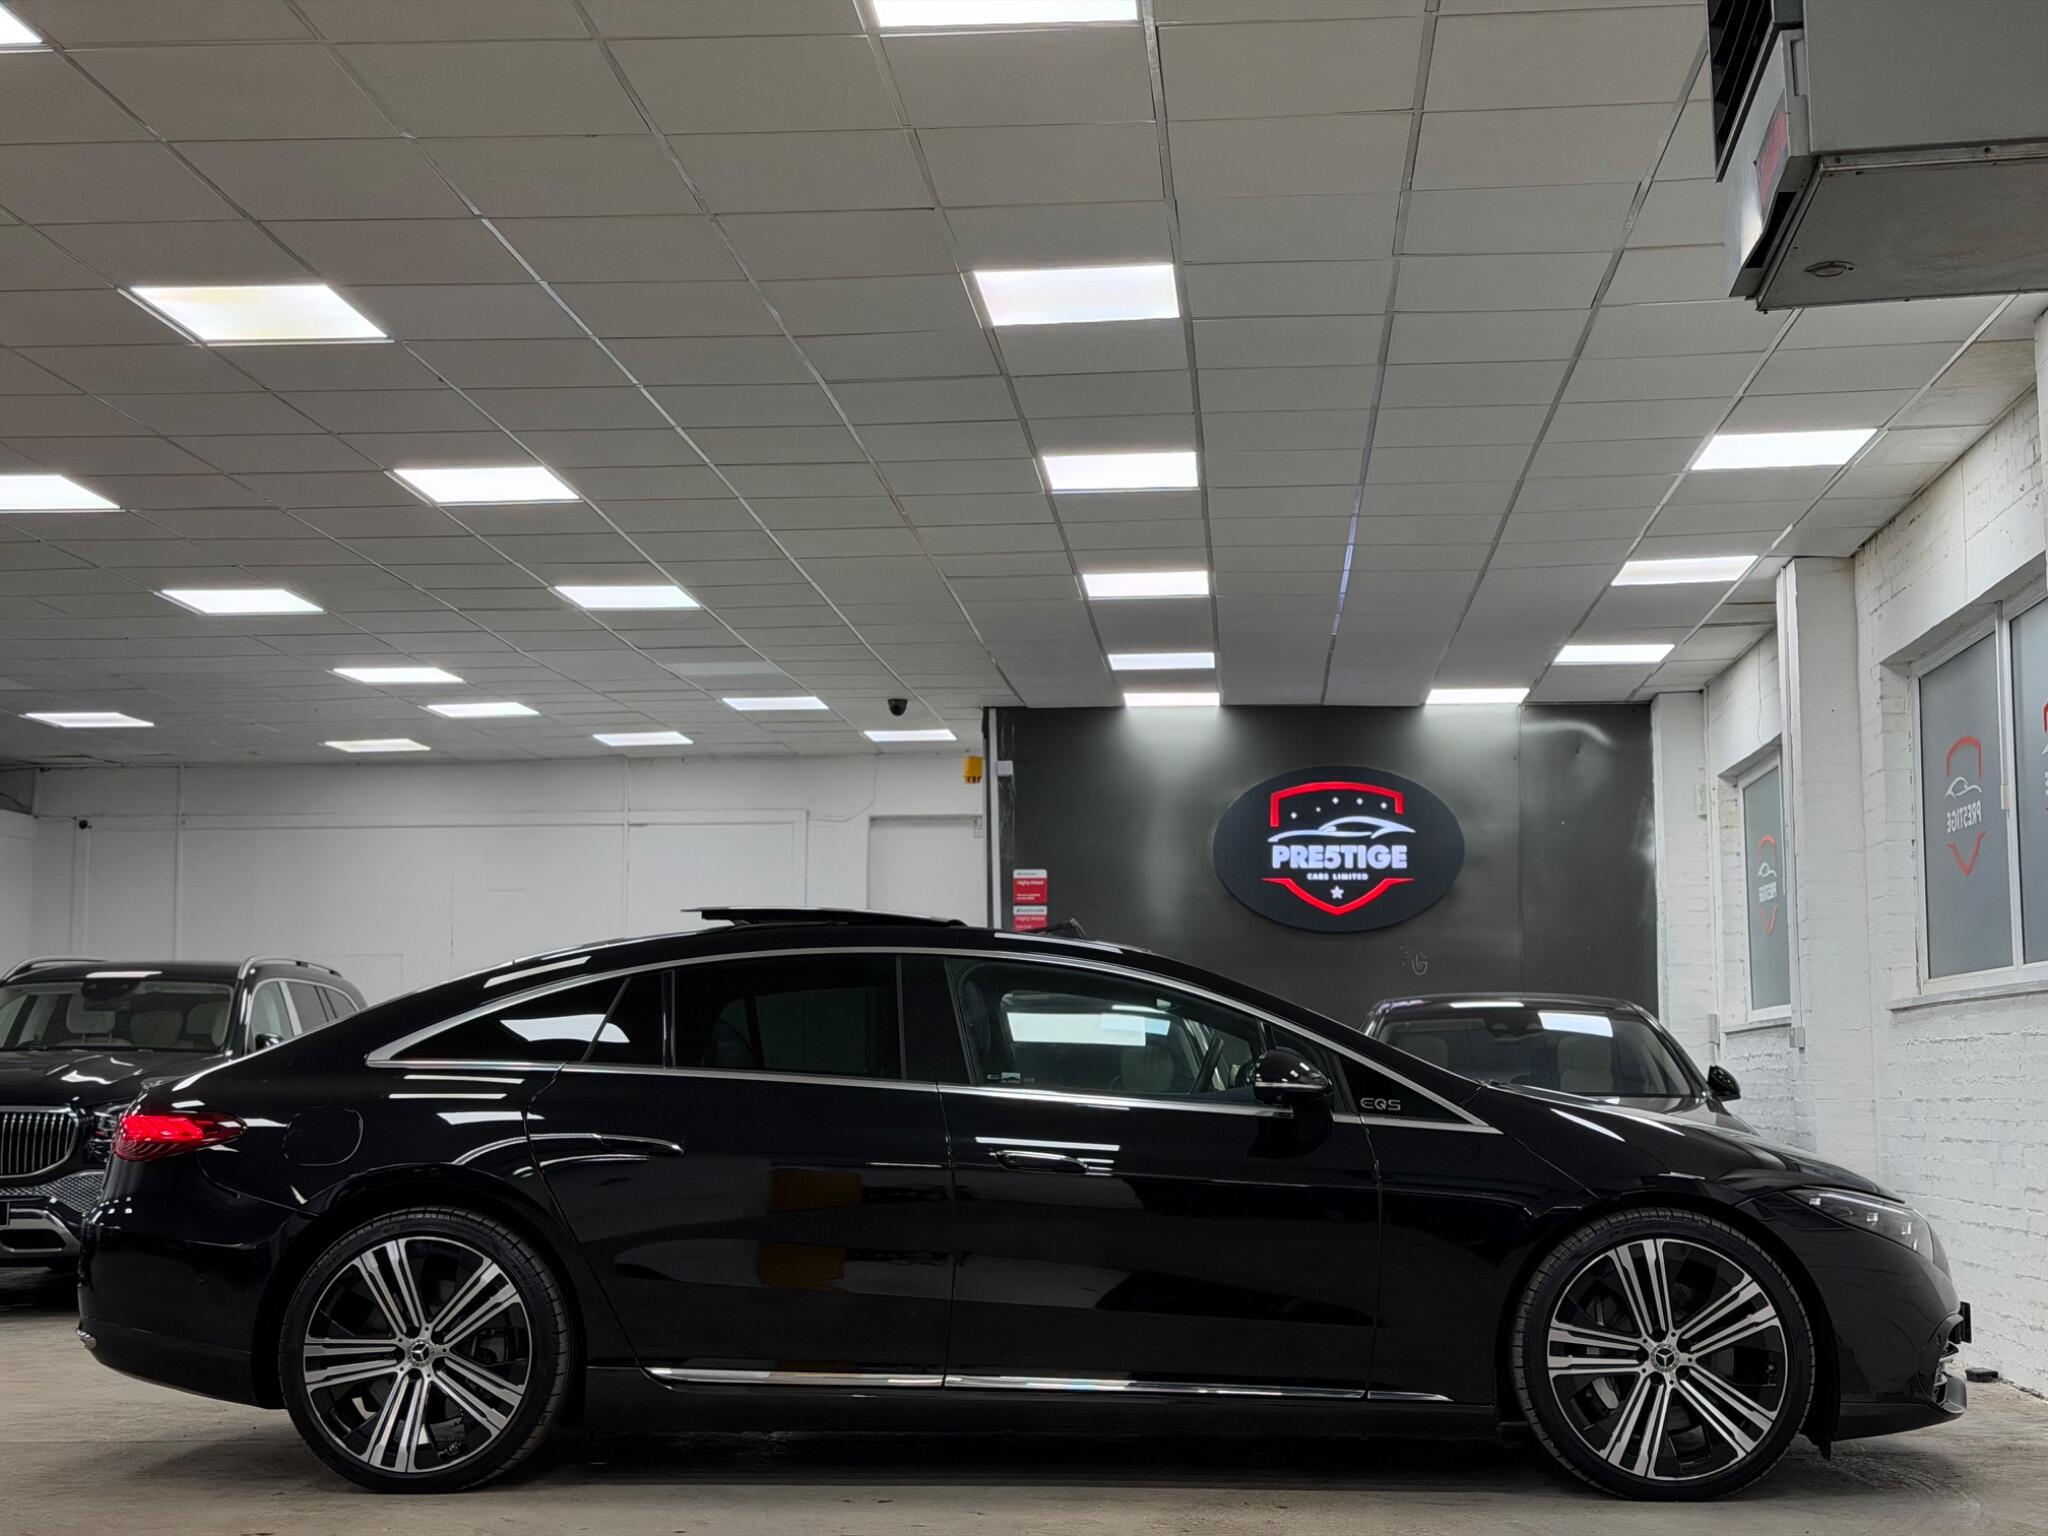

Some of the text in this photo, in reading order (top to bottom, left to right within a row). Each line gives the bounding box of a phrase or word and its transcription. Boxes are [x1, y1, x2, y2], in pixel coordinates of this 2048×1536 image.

[1306, 872, 1369, 881] CARS LIMITED
[1360, 1097, 1401, 1111] EQS
